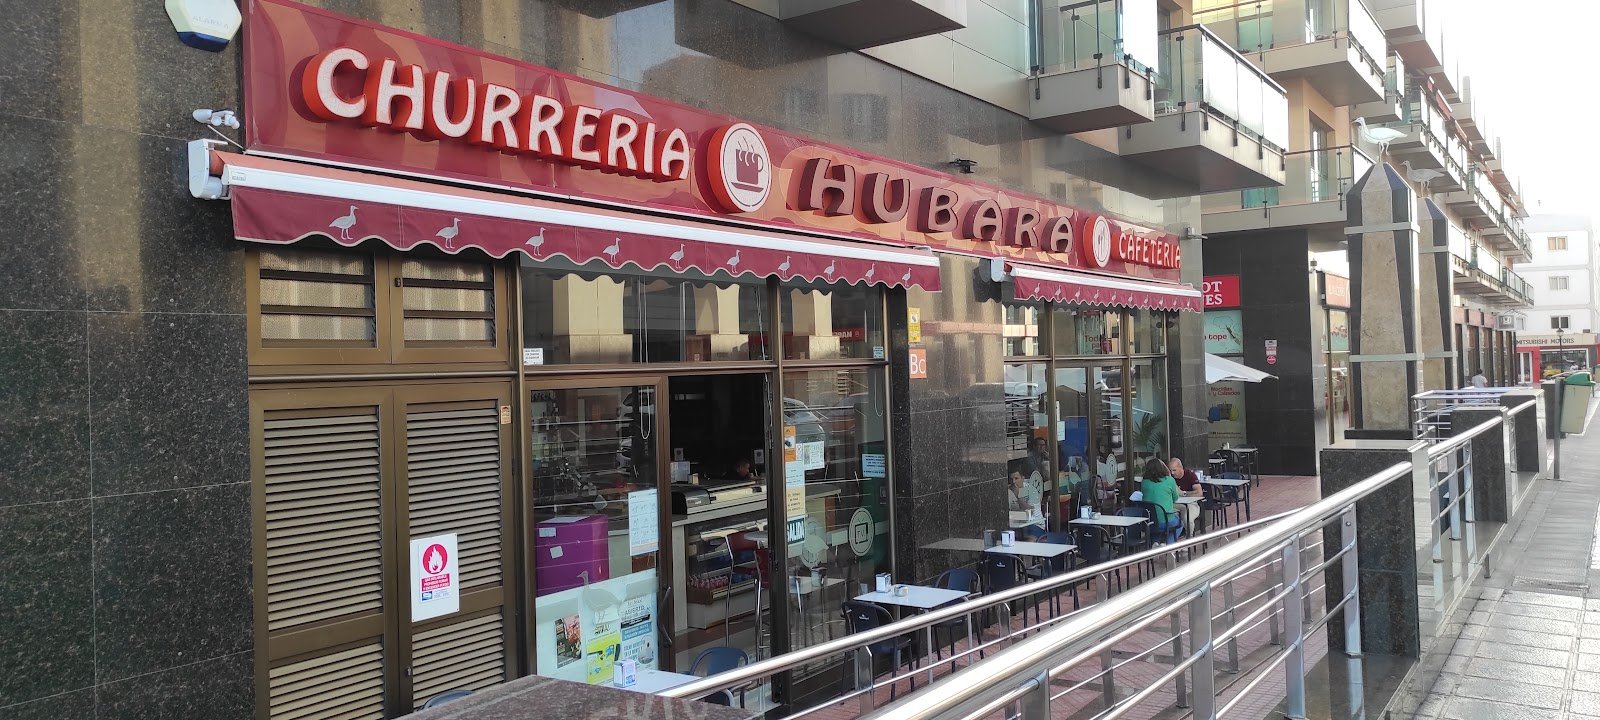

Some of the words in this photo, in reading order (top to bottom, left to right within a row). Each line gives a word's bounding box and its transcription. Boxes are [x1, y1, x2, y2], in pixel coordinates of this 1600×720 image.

[305, 46, 691, 181] CHURRERIA
[800, 157, 1073, 253] HUBARA
[1118, 232, 1181, 268] CAFETERIA
[1202, 294, 1223, 305] ES
[1208, 333, 1228, 341] tope
